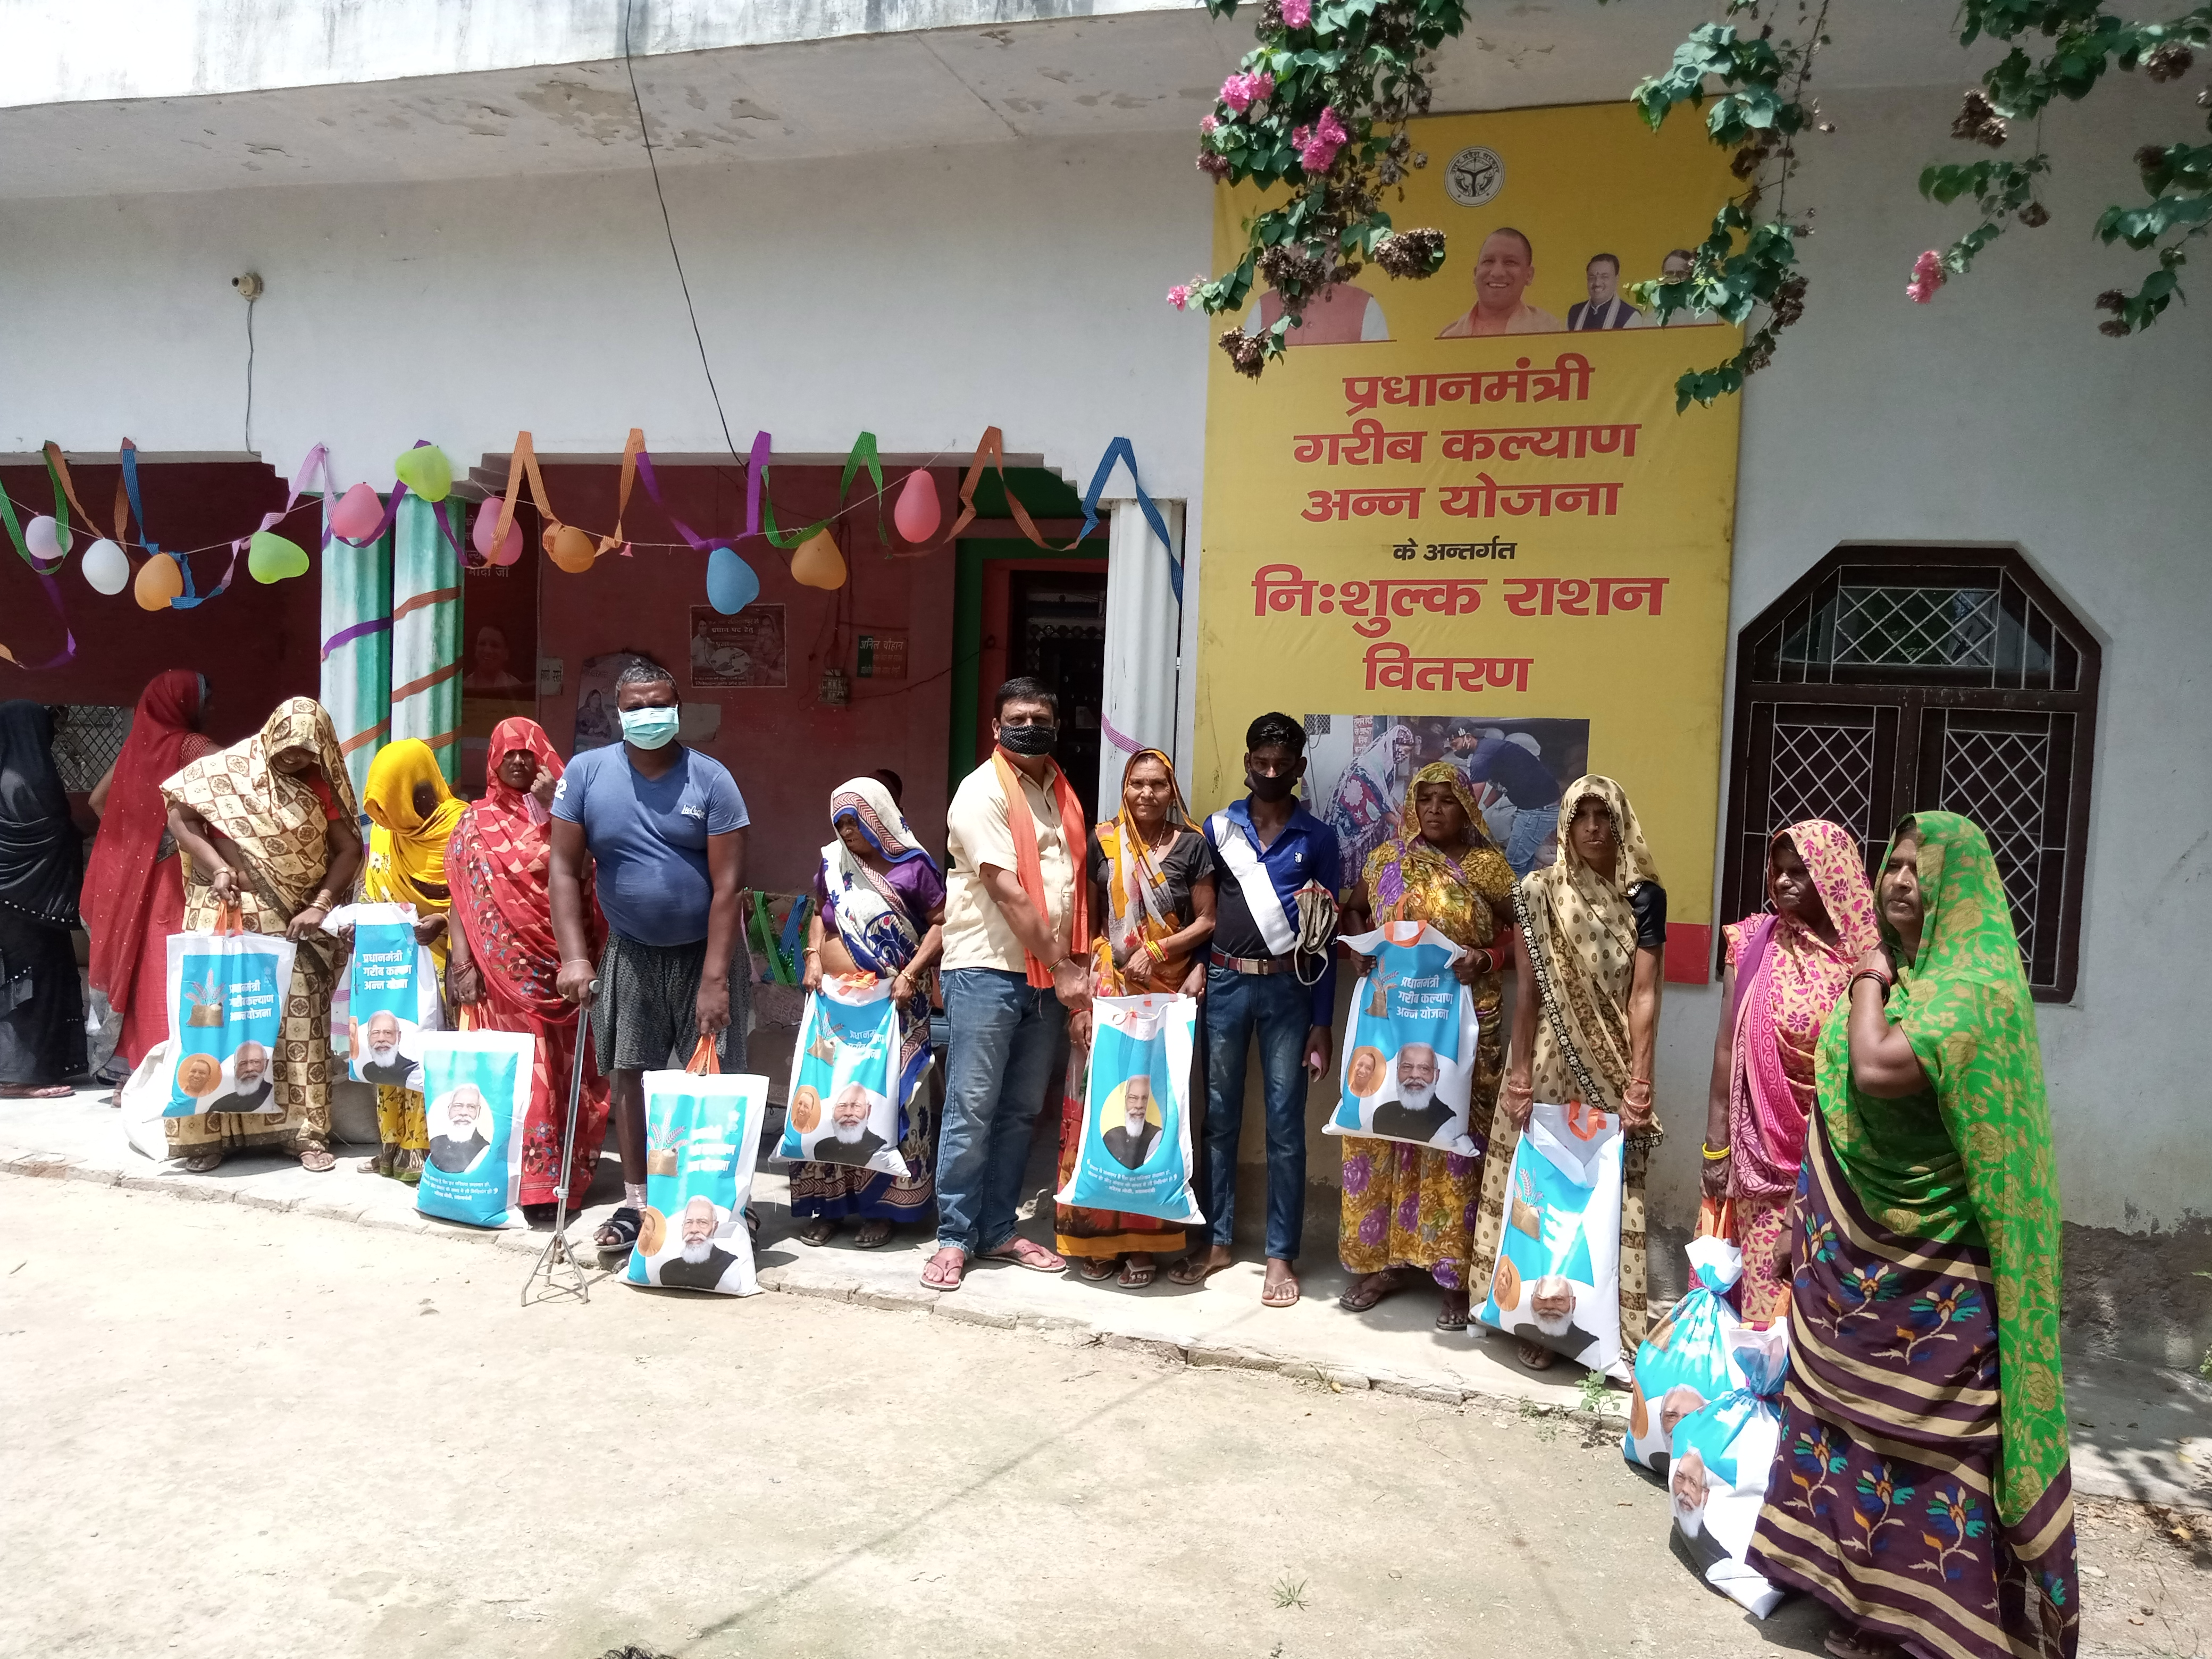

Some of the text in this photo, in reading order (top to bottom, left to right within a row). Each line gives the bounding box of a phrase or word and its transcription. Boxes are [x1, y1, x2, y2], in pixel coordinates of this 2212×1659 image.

[1343, 353, 1594, 416] प्रधानमंत्री
[1294, 418, 1641, 466] गरीब कल्याण
[1301, 473, 1623, 522] अन्न योजना
[1393, 535, 1518, 562] के अन्तर्गत
[1252, 564, 1669, 638] निःशुल्क राशन
[860, 638, 881, 650] अनिल
[1363, 642, 1534, 693] वितरण
[362, 949, 403, 963] प्रधानमंत्री
[363, 964, 412, 976] गरीब कल्ण
[364, 981, 385, 990] अन्न
[1401, 974, 1440, 988] प्रधानमंत्री
[246, 994, 274, 1006] कल्याण
[1398, 990, 1454, 1004] गरीब कल्याण
[247, 1008, 272, 1020] योजना
[1396, 1006, 1449, 1020] अन्न योजना
